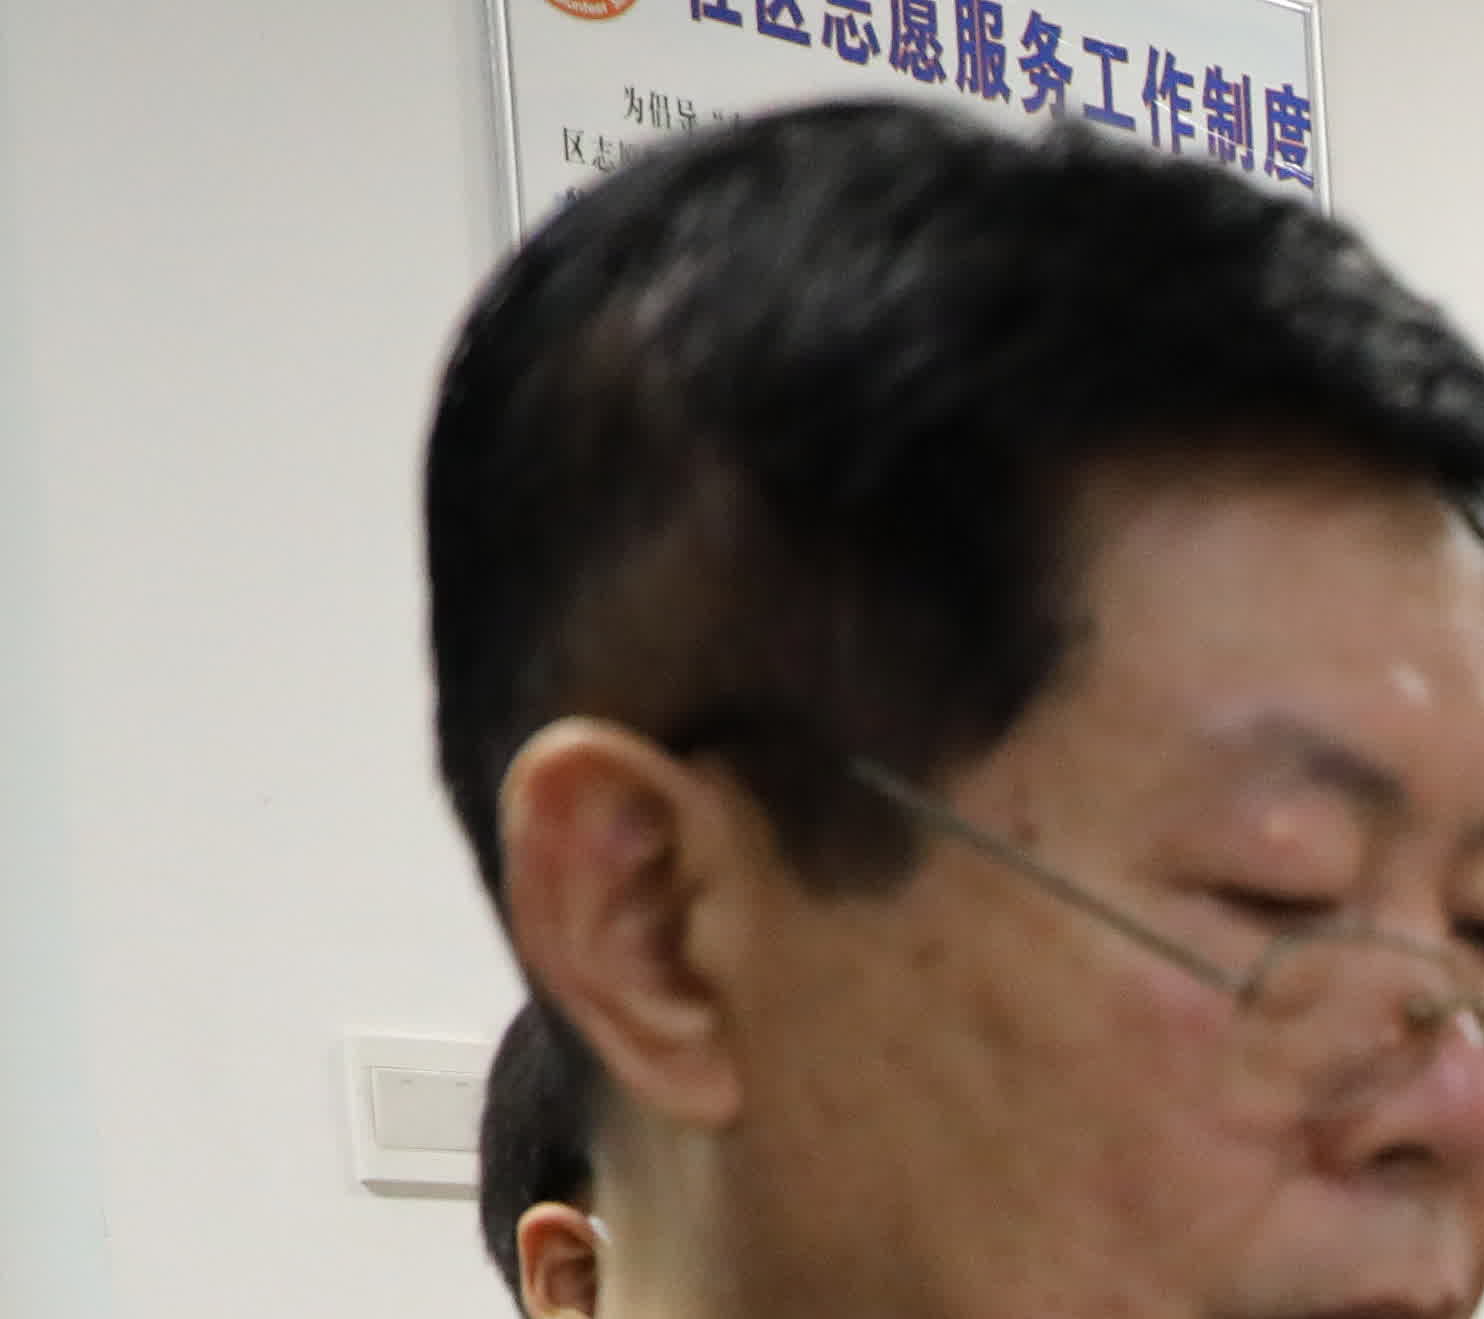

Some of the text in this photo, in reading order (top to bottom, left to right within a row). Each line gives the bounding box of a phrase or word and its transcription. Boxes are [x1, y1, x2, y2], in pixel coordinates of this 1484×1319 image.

[688, 0, 1314, 189] 志愿服务工作制度
